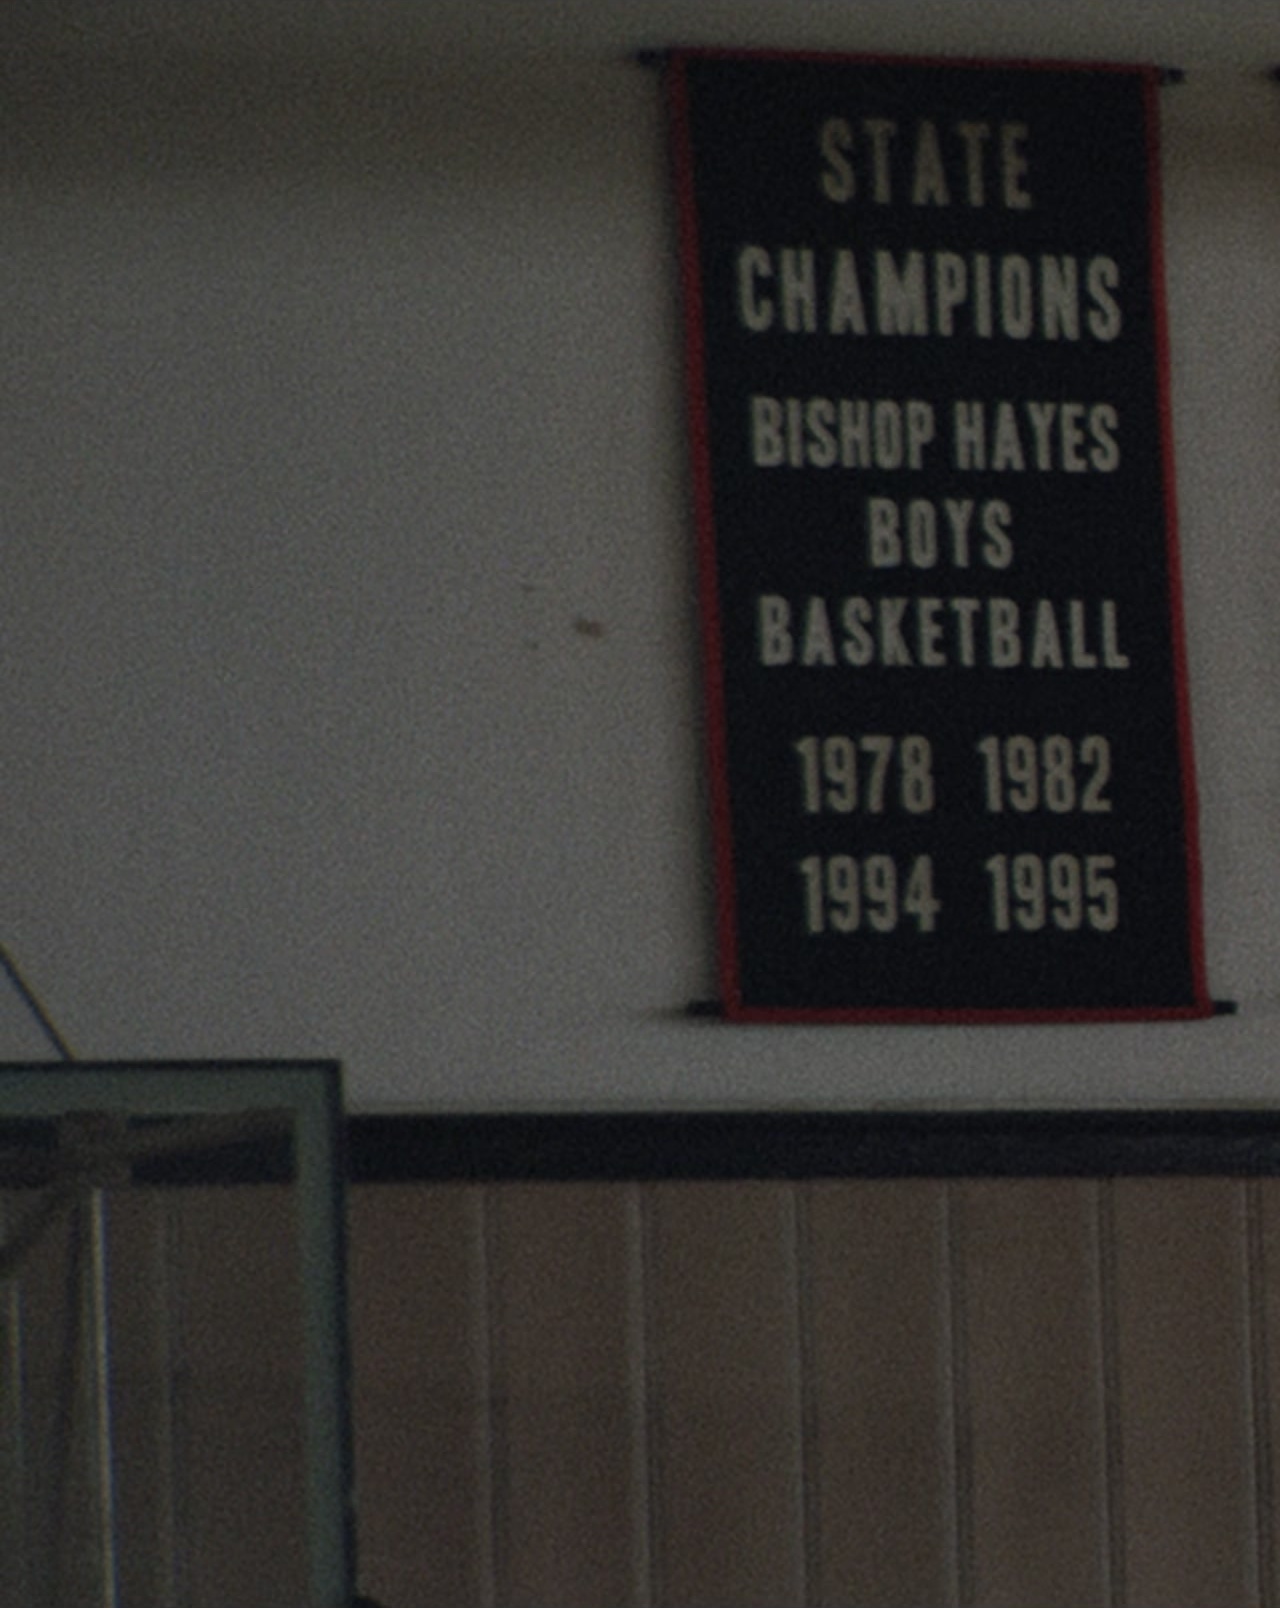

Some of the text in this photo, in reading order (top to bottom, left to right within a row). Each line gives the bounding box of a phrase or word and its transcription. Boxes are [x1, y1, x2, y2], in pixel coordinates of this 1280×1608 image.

[819, 117, 1033, 209] STATE
[737, 245, 1123, 342] CHAMPIONS
[750, 395, 1121, 472] BISHOP HAYES
[867, 497, 1013, 569] BOYS
[759, 595, 1130, 670] BASKETBALL
[793, 734, 1112, 814] 1978 1982
[800, 852, 1119, 934] 1994 1995
